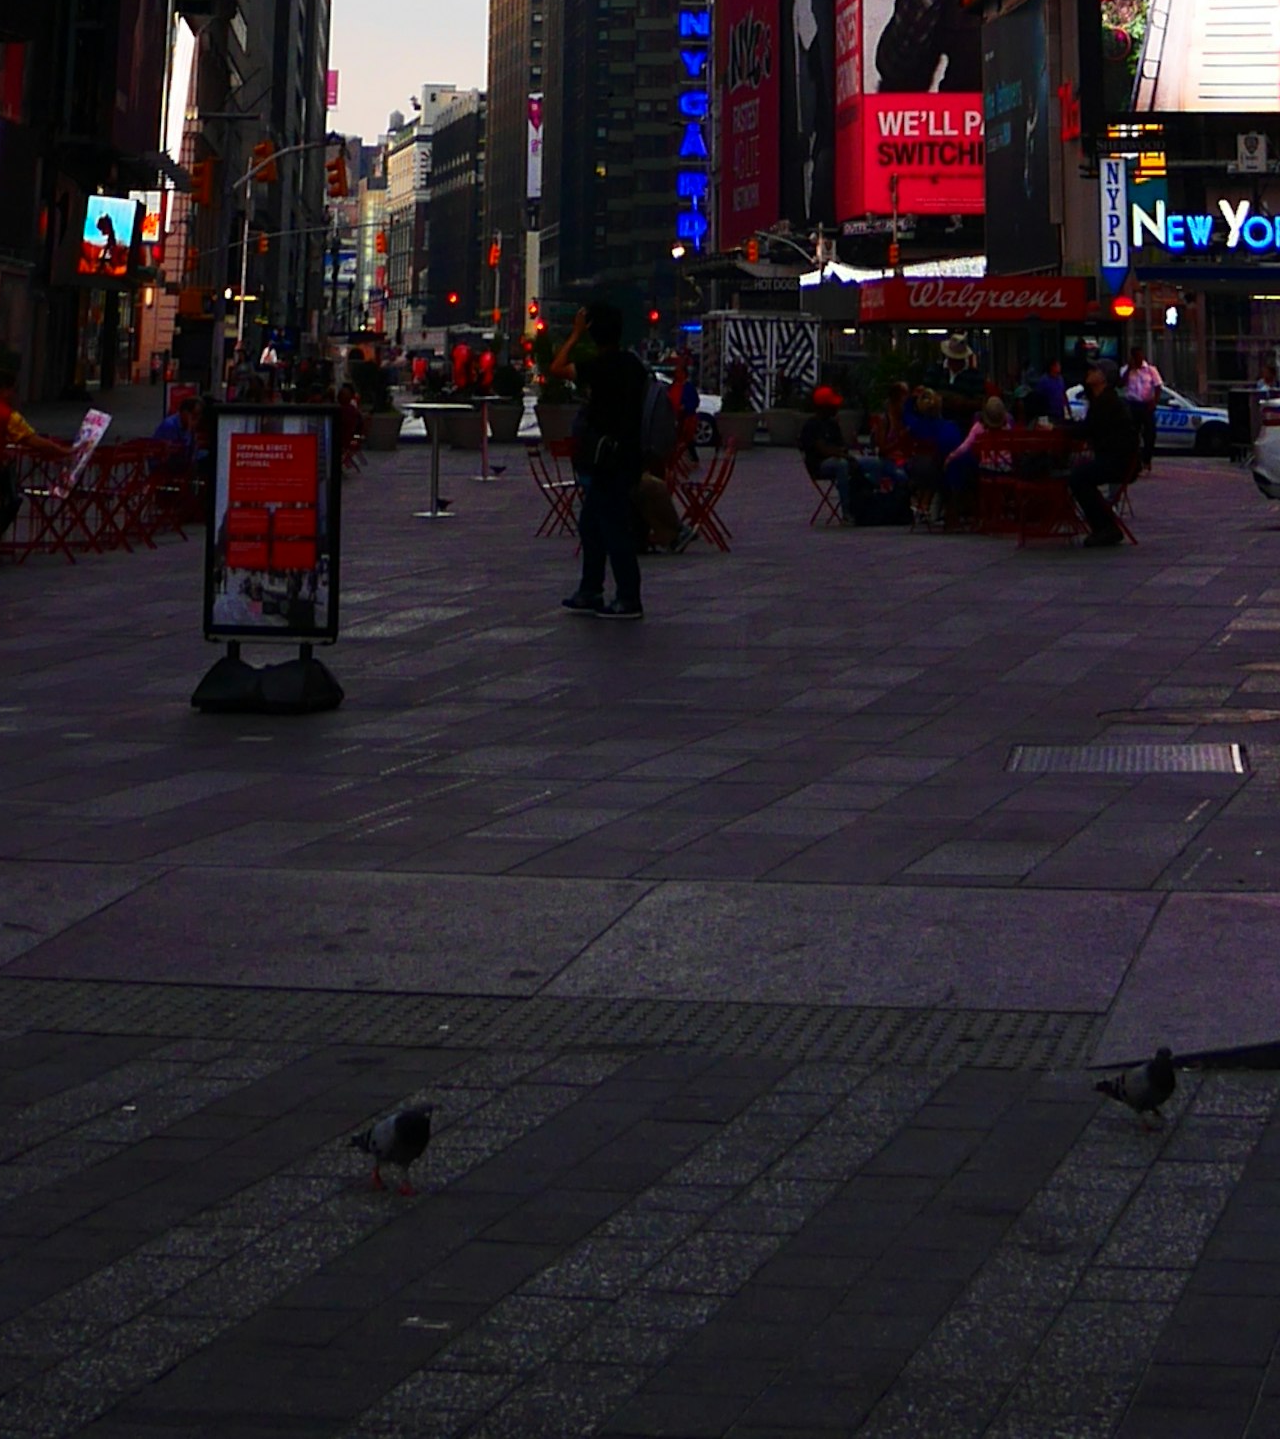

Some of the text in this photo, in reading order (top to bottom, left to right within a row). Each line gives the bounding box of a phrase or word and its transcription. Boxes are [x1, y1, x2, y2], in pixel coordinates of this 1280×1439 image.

[877, 110, 959, 137] WE'LL
[1106, 162, 1121, 263] NYPD
[906, 281, 1069, 318] Walgreens
